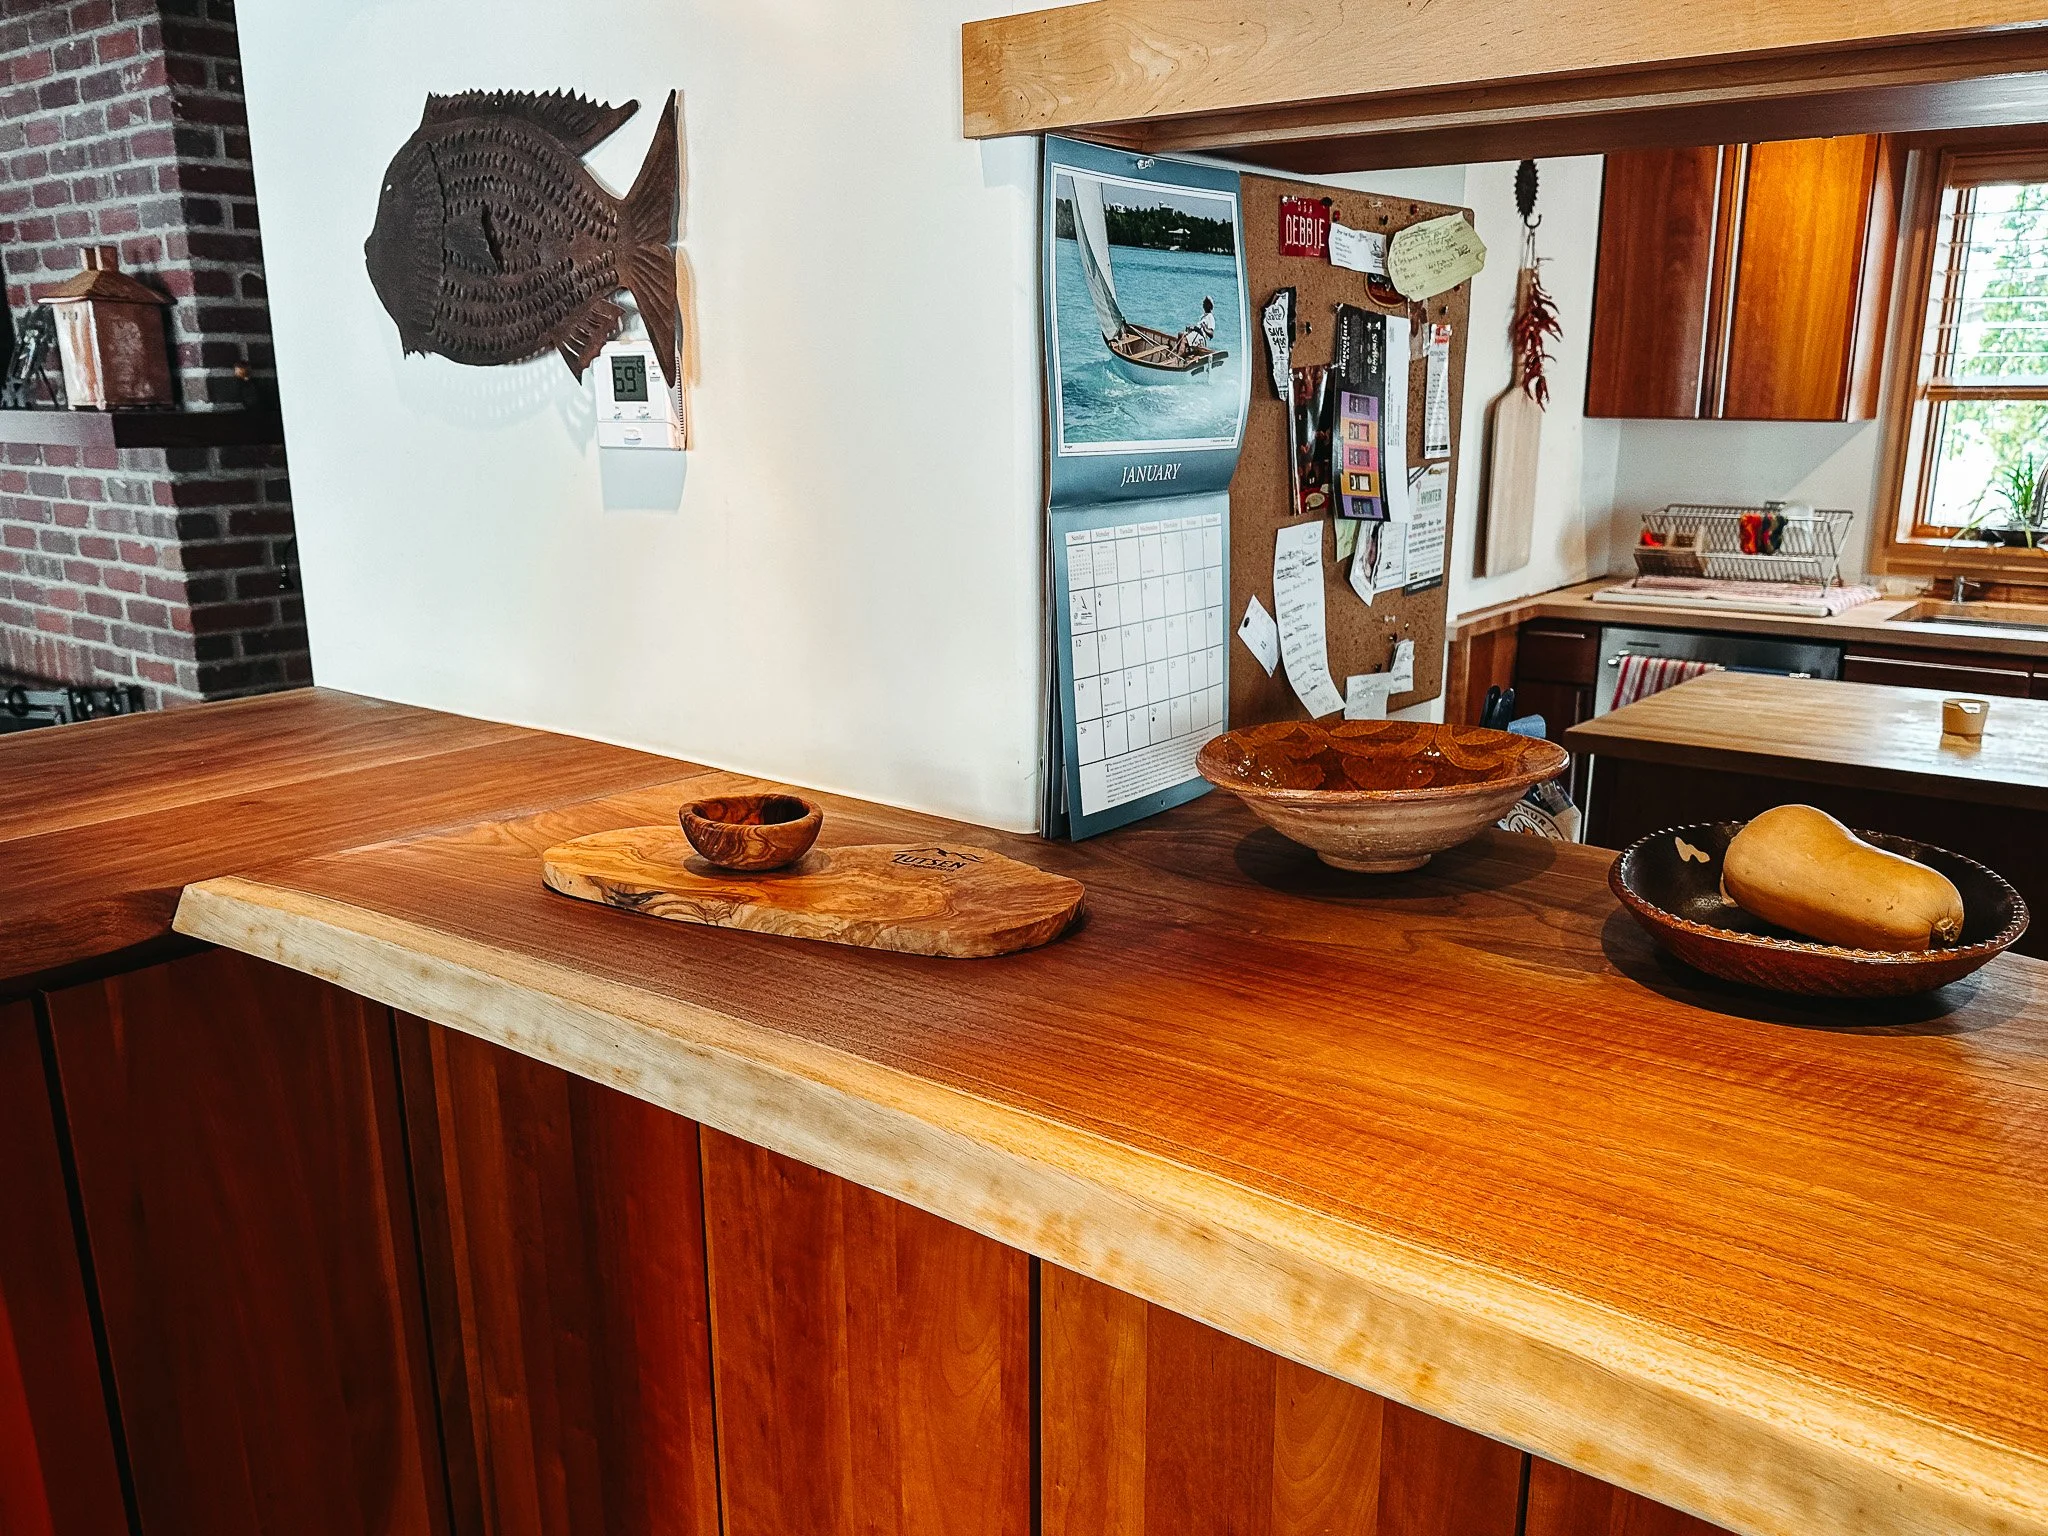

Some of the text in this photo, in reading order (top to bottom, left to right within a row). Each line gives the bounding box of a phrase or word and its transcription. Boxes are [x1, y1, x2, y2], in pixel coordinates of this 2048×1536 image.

[1285, 214, 1325, 249] DEBBIE
[1267, 326, 1285, 337] SAVE
[1120, 462, 1182, 487] JANUARY
[1075, 639, 1082, 647] 12
[1077, 683, 1085, 691] 19
[1080, 727, 1087, 735] 26
[1106, 720, 1112, 728] 27
[890, 853, 968, 869] LUTSEN
